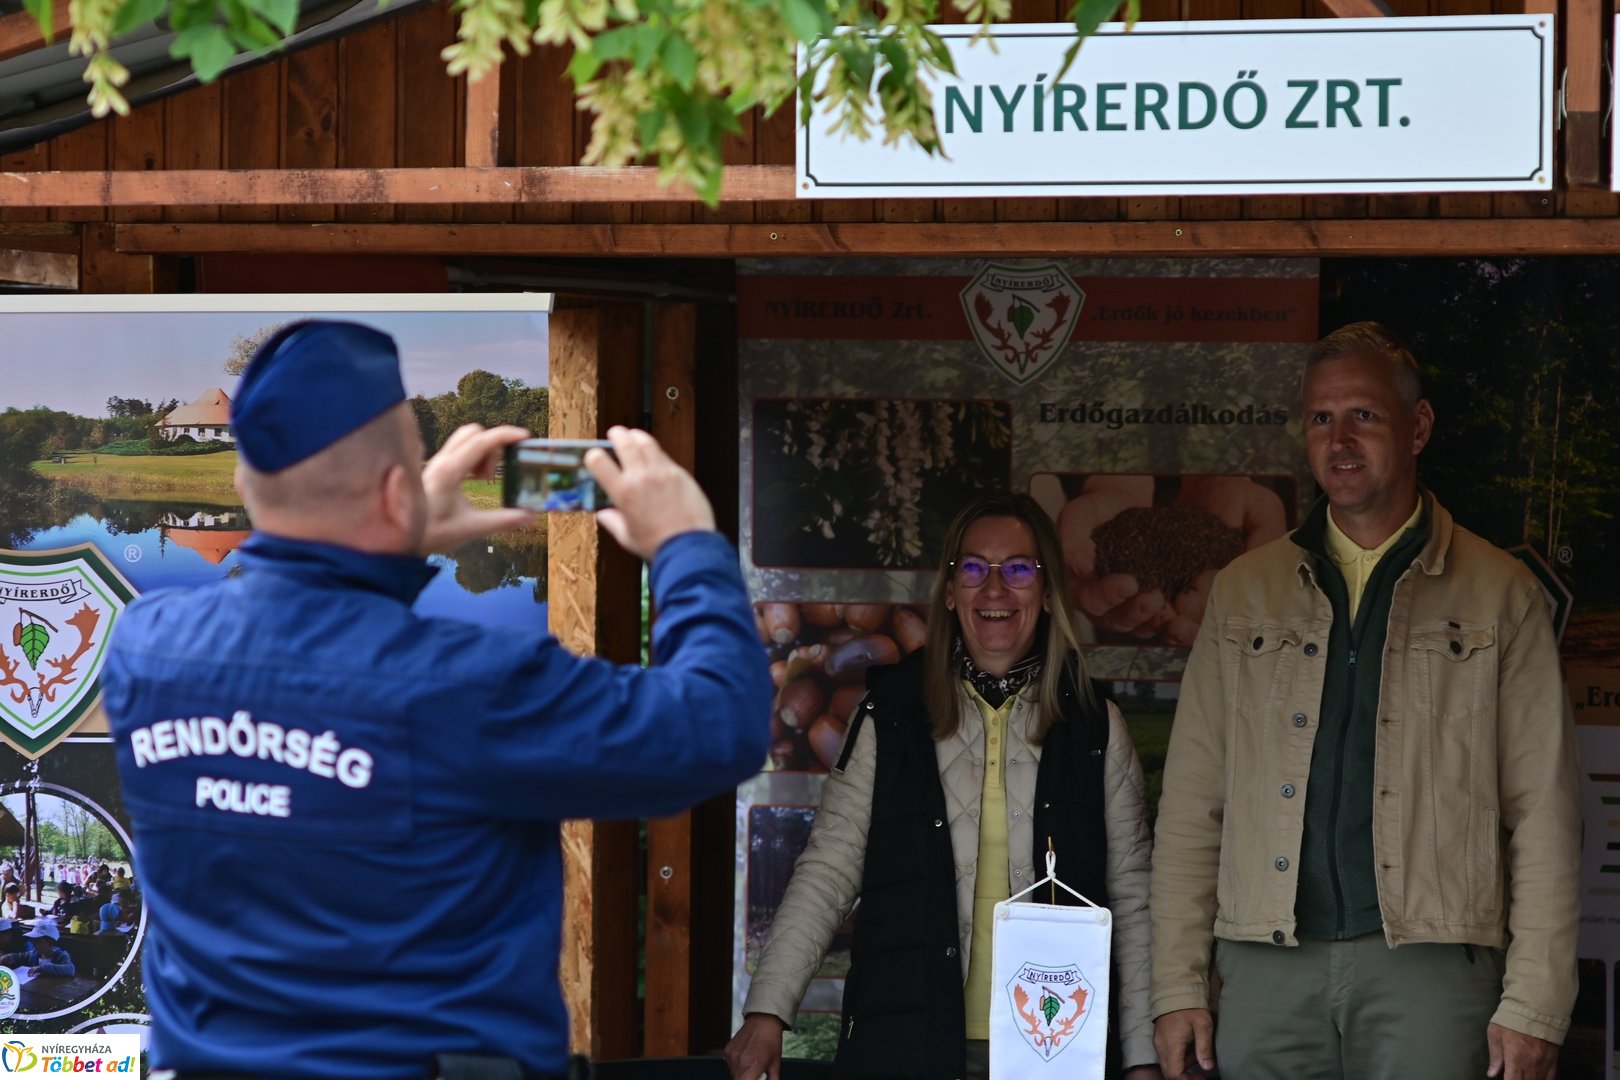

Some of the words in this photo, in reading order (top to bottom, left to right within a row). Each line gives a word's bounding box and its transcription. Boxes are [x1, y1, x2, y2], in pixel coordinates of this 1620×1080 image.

[945, 71, 1268, 133] NYÍRERDŐ
[1285, 77, 1411, 129] ZRT.
[995, 277, 1051, 288] NYÍRERDŐ
[765, 296, 884, 319] NYÍRERDŐ
[892, 301, 933, 319] Zrt.
[1162, 304, 1184, 325] jó
[1039, 402, 1289, 430] Erdőgazdálkodás
[130, 710, 374, 789] RENDŐRSÉG
[195, 776, 292, 818] POLICE
